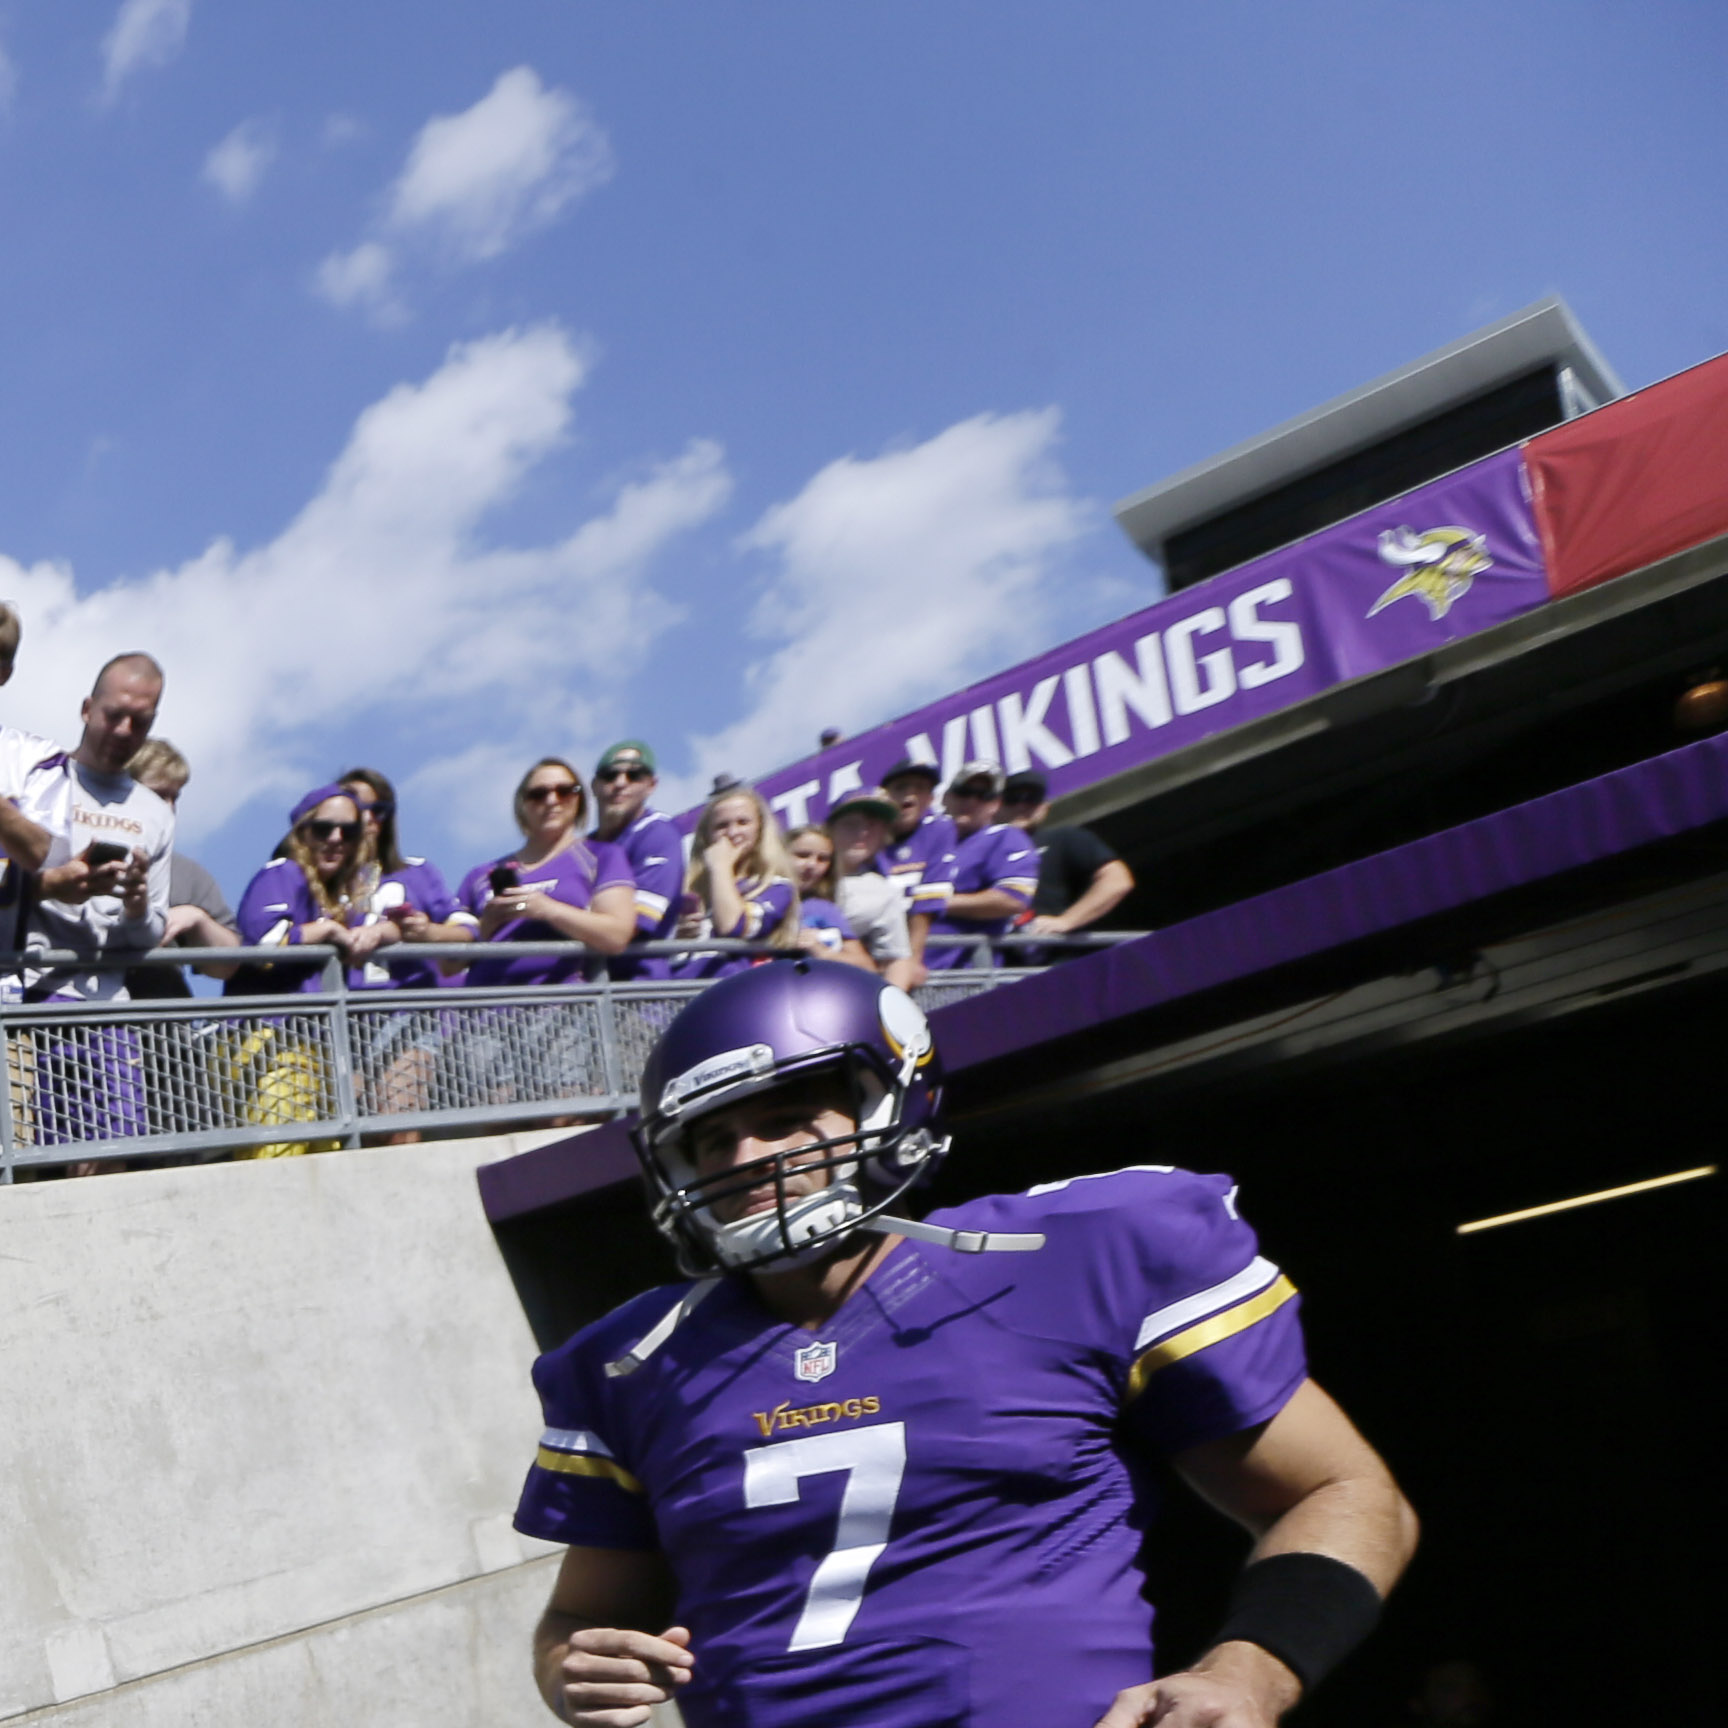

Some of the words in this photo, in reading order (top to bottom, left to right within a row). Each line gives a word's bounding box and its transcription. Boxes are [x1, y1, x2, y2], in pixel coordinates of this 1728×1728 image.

[903, 578, 1305, 812] VIKINGS
[72, 804, 143, 834] IKINGS
[753, 1395, 881, 1437] VIKINGS
[744, 1421, 907, 1653] 7
